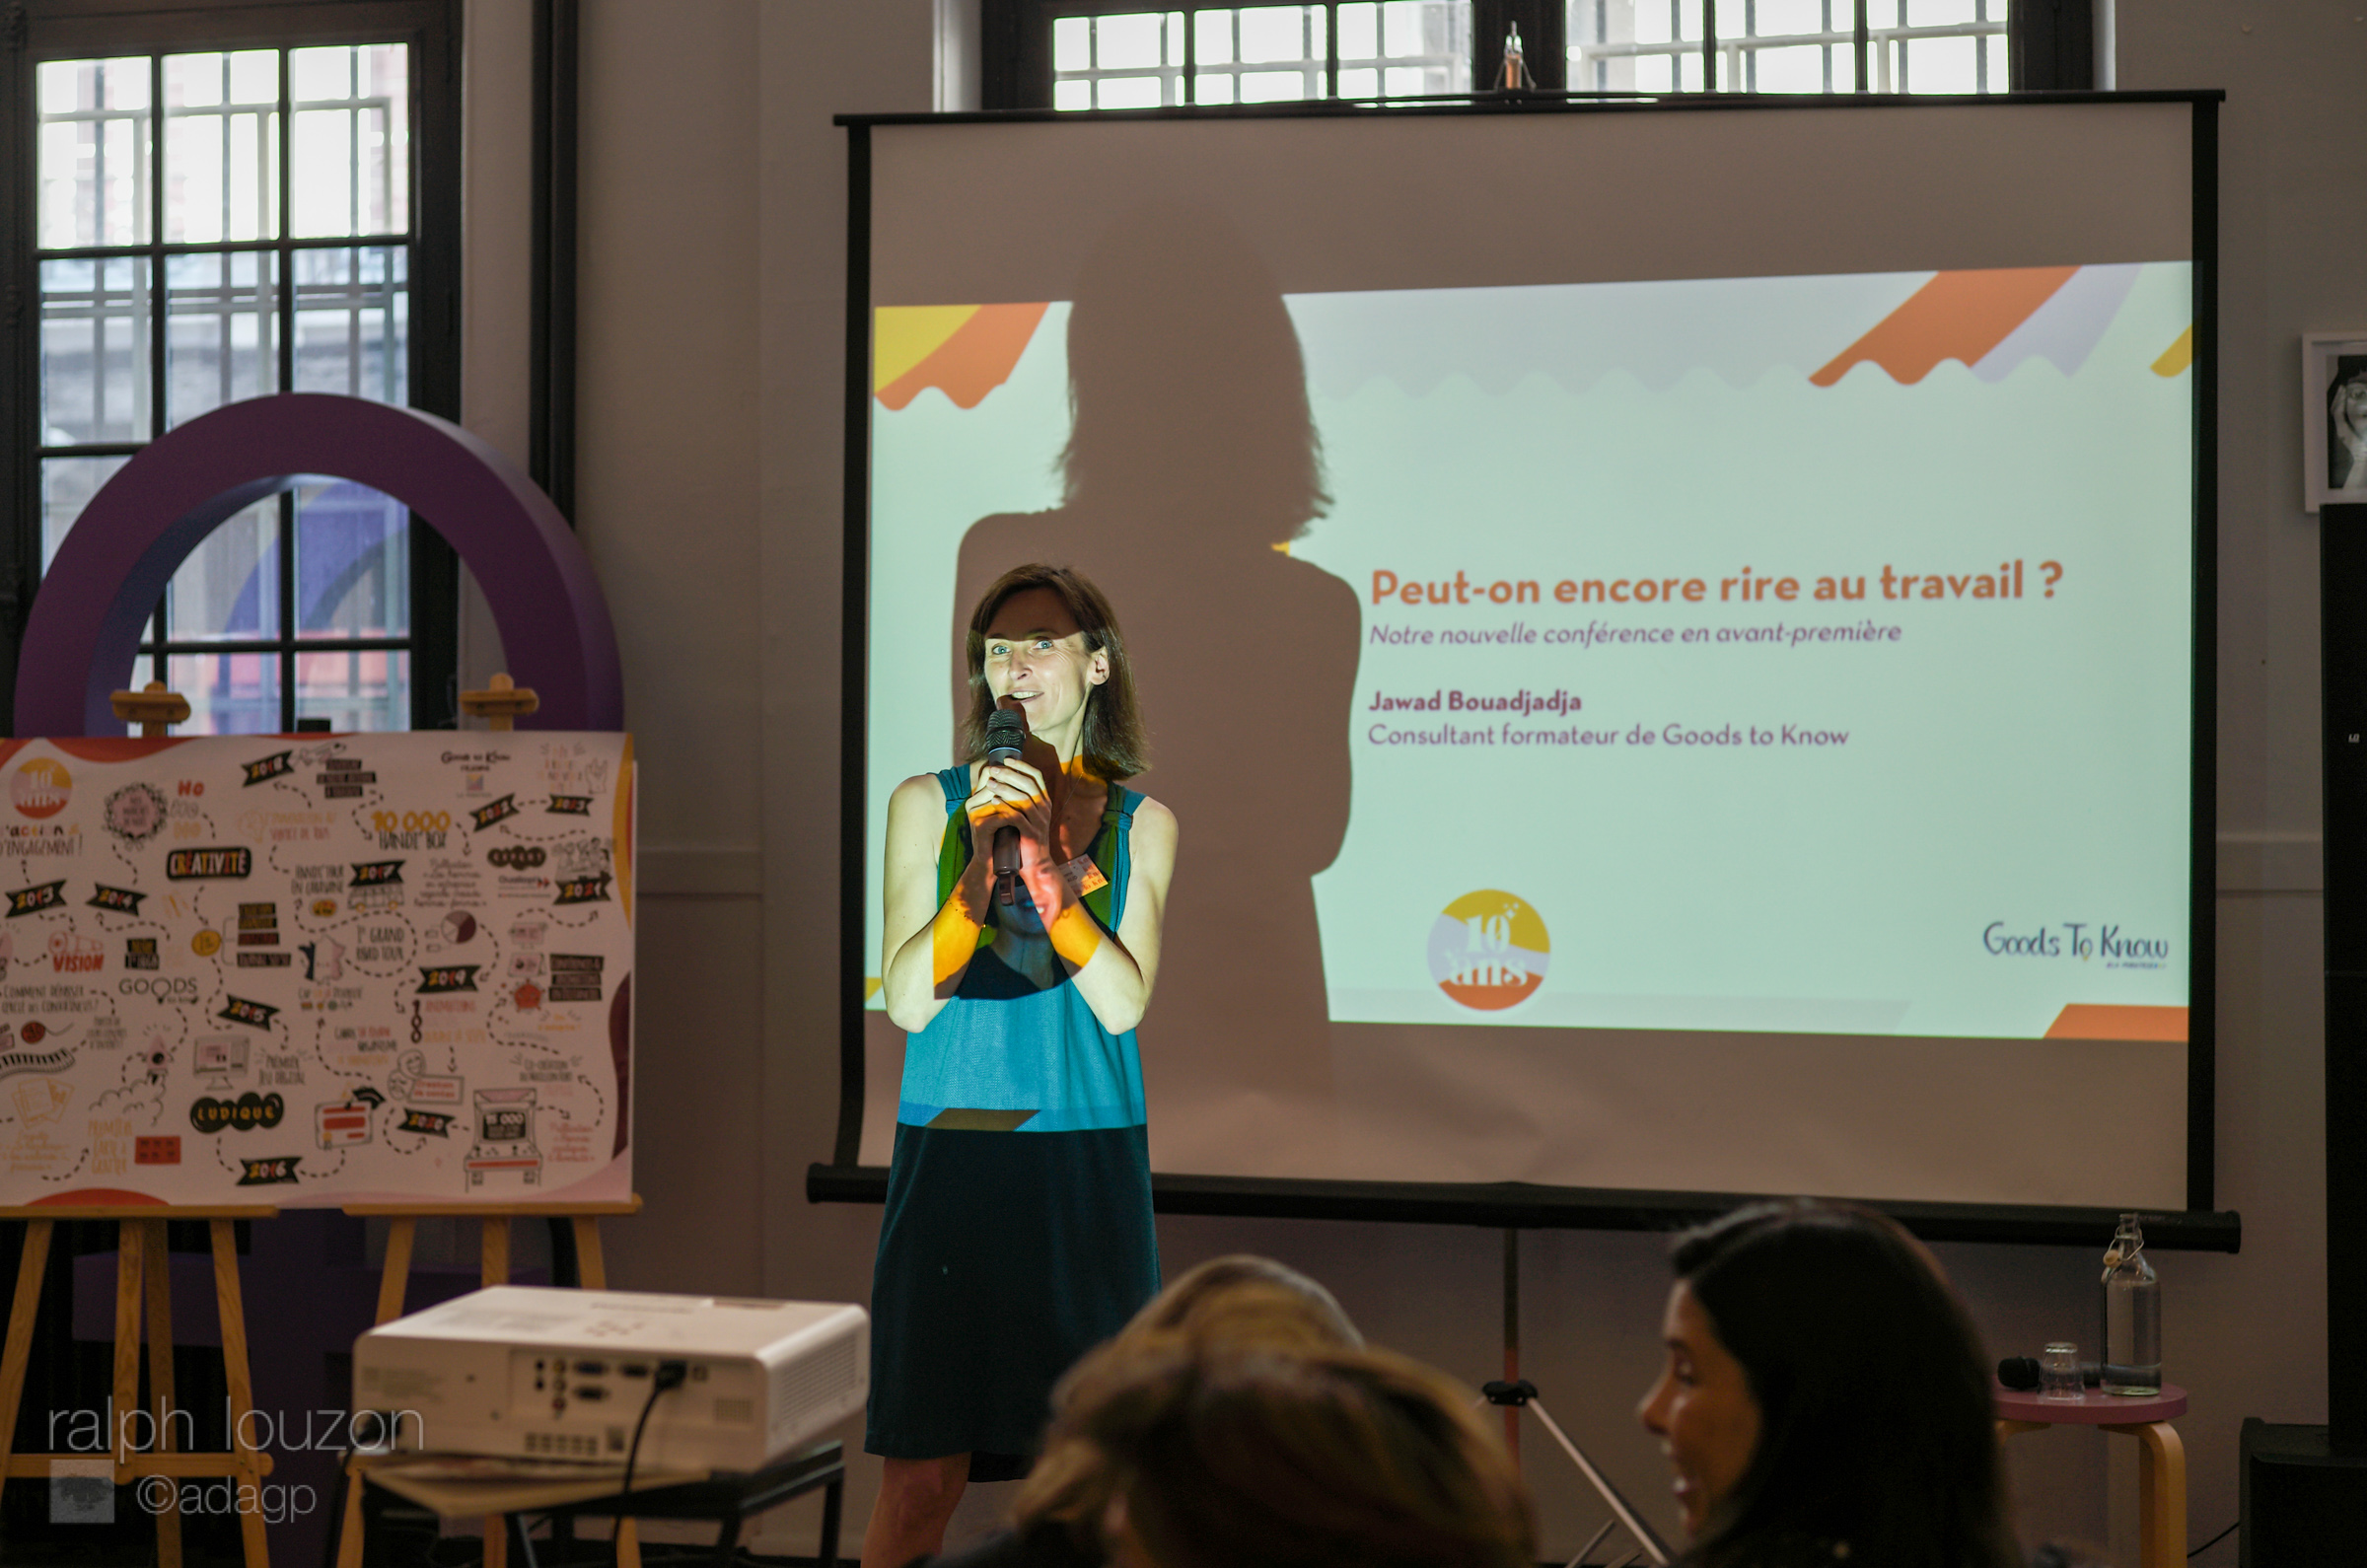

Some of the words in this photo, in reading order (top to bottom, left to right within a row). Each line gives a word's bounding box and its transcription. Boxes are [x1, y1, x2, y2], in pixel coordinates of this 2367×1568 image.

[1372, 569, 1541, 606] Peut-on
[1553, 576, 1706, 604] encore
[1720, 566, 1800, 602] rire
[1812, 574, 1866, 601] au
[1879, 559, 2024, 601] travail
[2039, 559, 2063, 600] ?
[1369, 623, 1435, 646] Notre
[1440, 622, 1538, 645] nouvelle
[1542, 619, 1675, 649] conférence
[1681, 625, 1710, 644] en
[1715, 619, 1902, 649] avant-première
[1368, 689, 1442, 713] Jawad
[1447, 689, 1583, 717] Bouadjadja
[1368, 723, 1495, 748] Consultant
[1501, 722, 1619, 748] formateur
[1624, 723, 1657, 747] de
[1662, 723, 1745, 747] Goods
[1749, 726, 1774, 746] to
[1780, 724, 1850, 747] Know
[371, 810, 397, 832] 10
[402, 810, 452, 832] 000
[1466, 913, 1511, 953] 10
[1982, 920, 2061, 958] Goods
[2062, 922, 2094, 962] To
[2100, 923, 2169, 960] Know
[1445, 954, 1529, 987] ans
[196, 1105, 276, 1122] LUDIQUE
